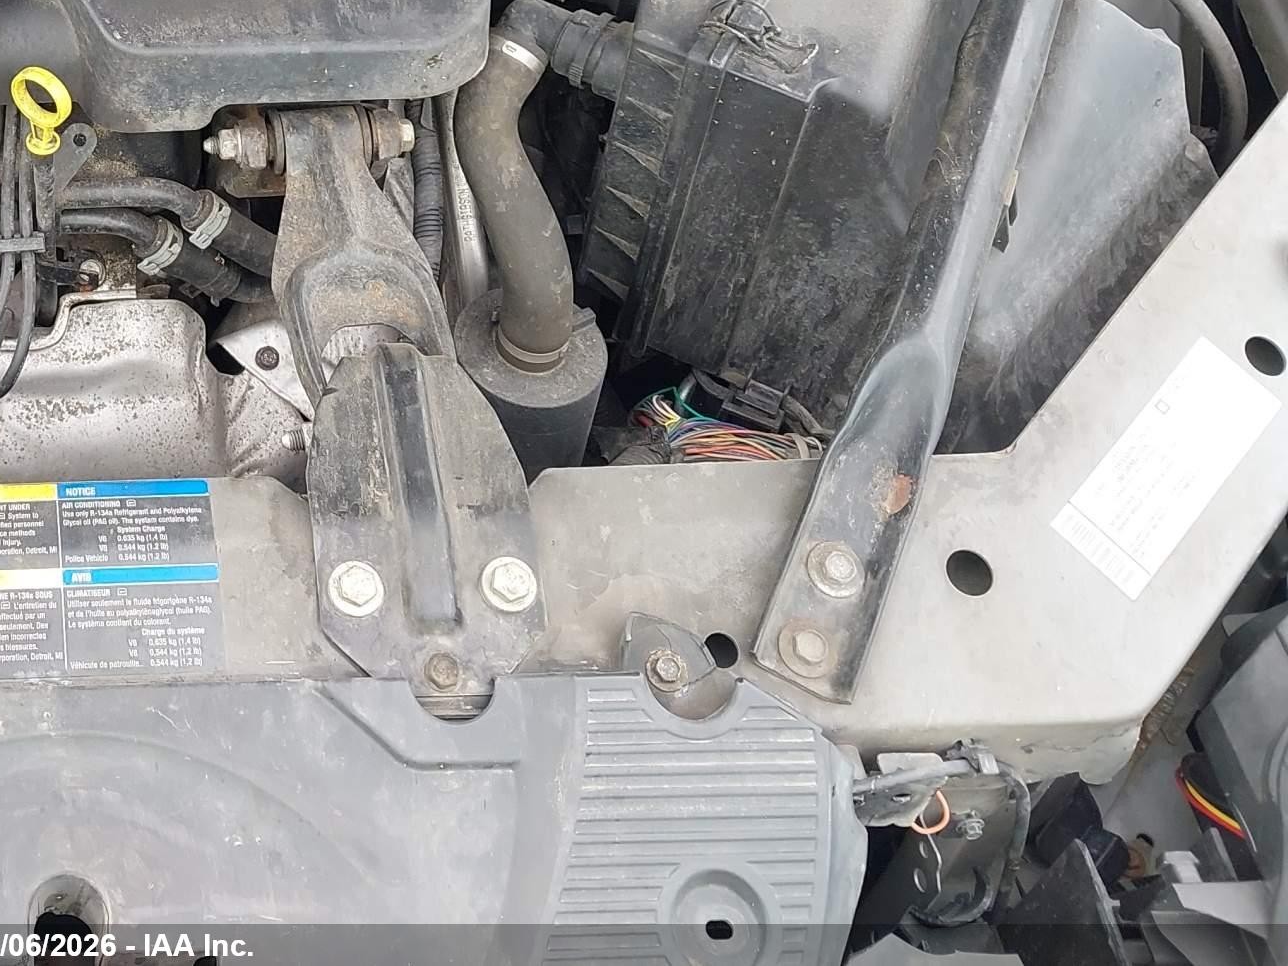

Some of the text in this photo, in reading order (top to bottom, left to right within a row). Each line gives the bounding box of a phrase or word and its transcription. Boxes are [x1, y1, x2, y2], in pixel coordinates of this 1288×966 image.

[65, 487, 96, 496] NOTICE
[62, 500, 121, 509] AIR CONDITIONING
[117, 525, 166, 534] System Charge
[25, 547, 49, 555] Detroit,
[65, 554, 109, 563] Police Vehicle
[71, 572, 92, 583] AVIS
